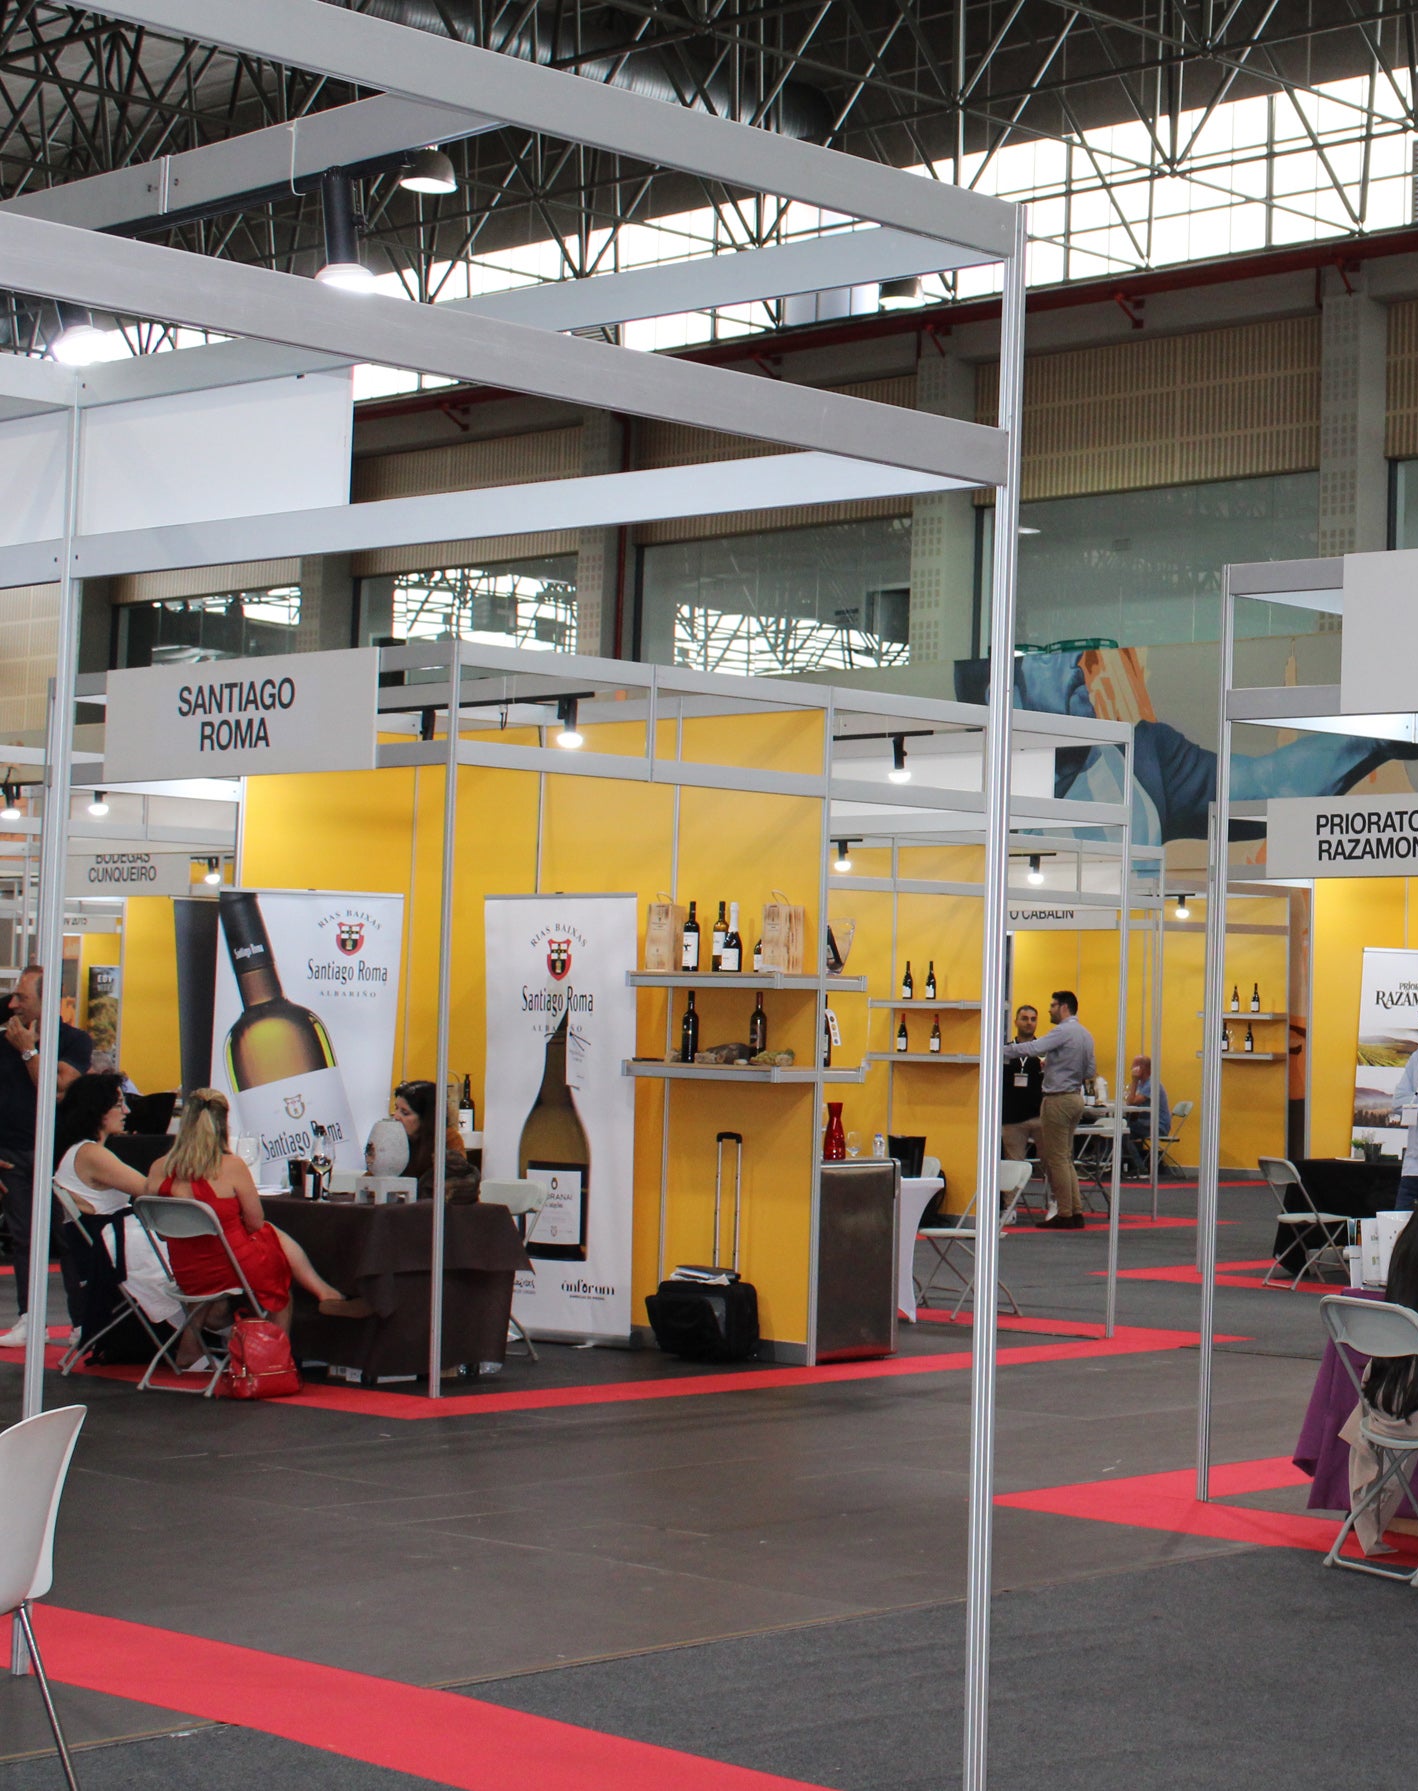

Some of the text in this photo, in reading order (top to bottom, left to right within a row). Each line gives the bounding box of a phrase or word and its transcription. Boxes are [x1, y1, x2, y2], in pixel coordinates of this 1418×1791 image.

[178, 677, 295, 716] SANTIAGO
[200, 717, 271, 752] ROMA
[88, 865, 157, 883] CUNQUEIRO
[529, 922, 588, 949] RIAS BAIXAS
[307, 958, 389, 986] Santiago Roma
[319, 989, 377, 999] ALBARIÑO
[521, 984, 595, 1018] Santiago Roma
[261, 1131, 311, 1161] Santiago
